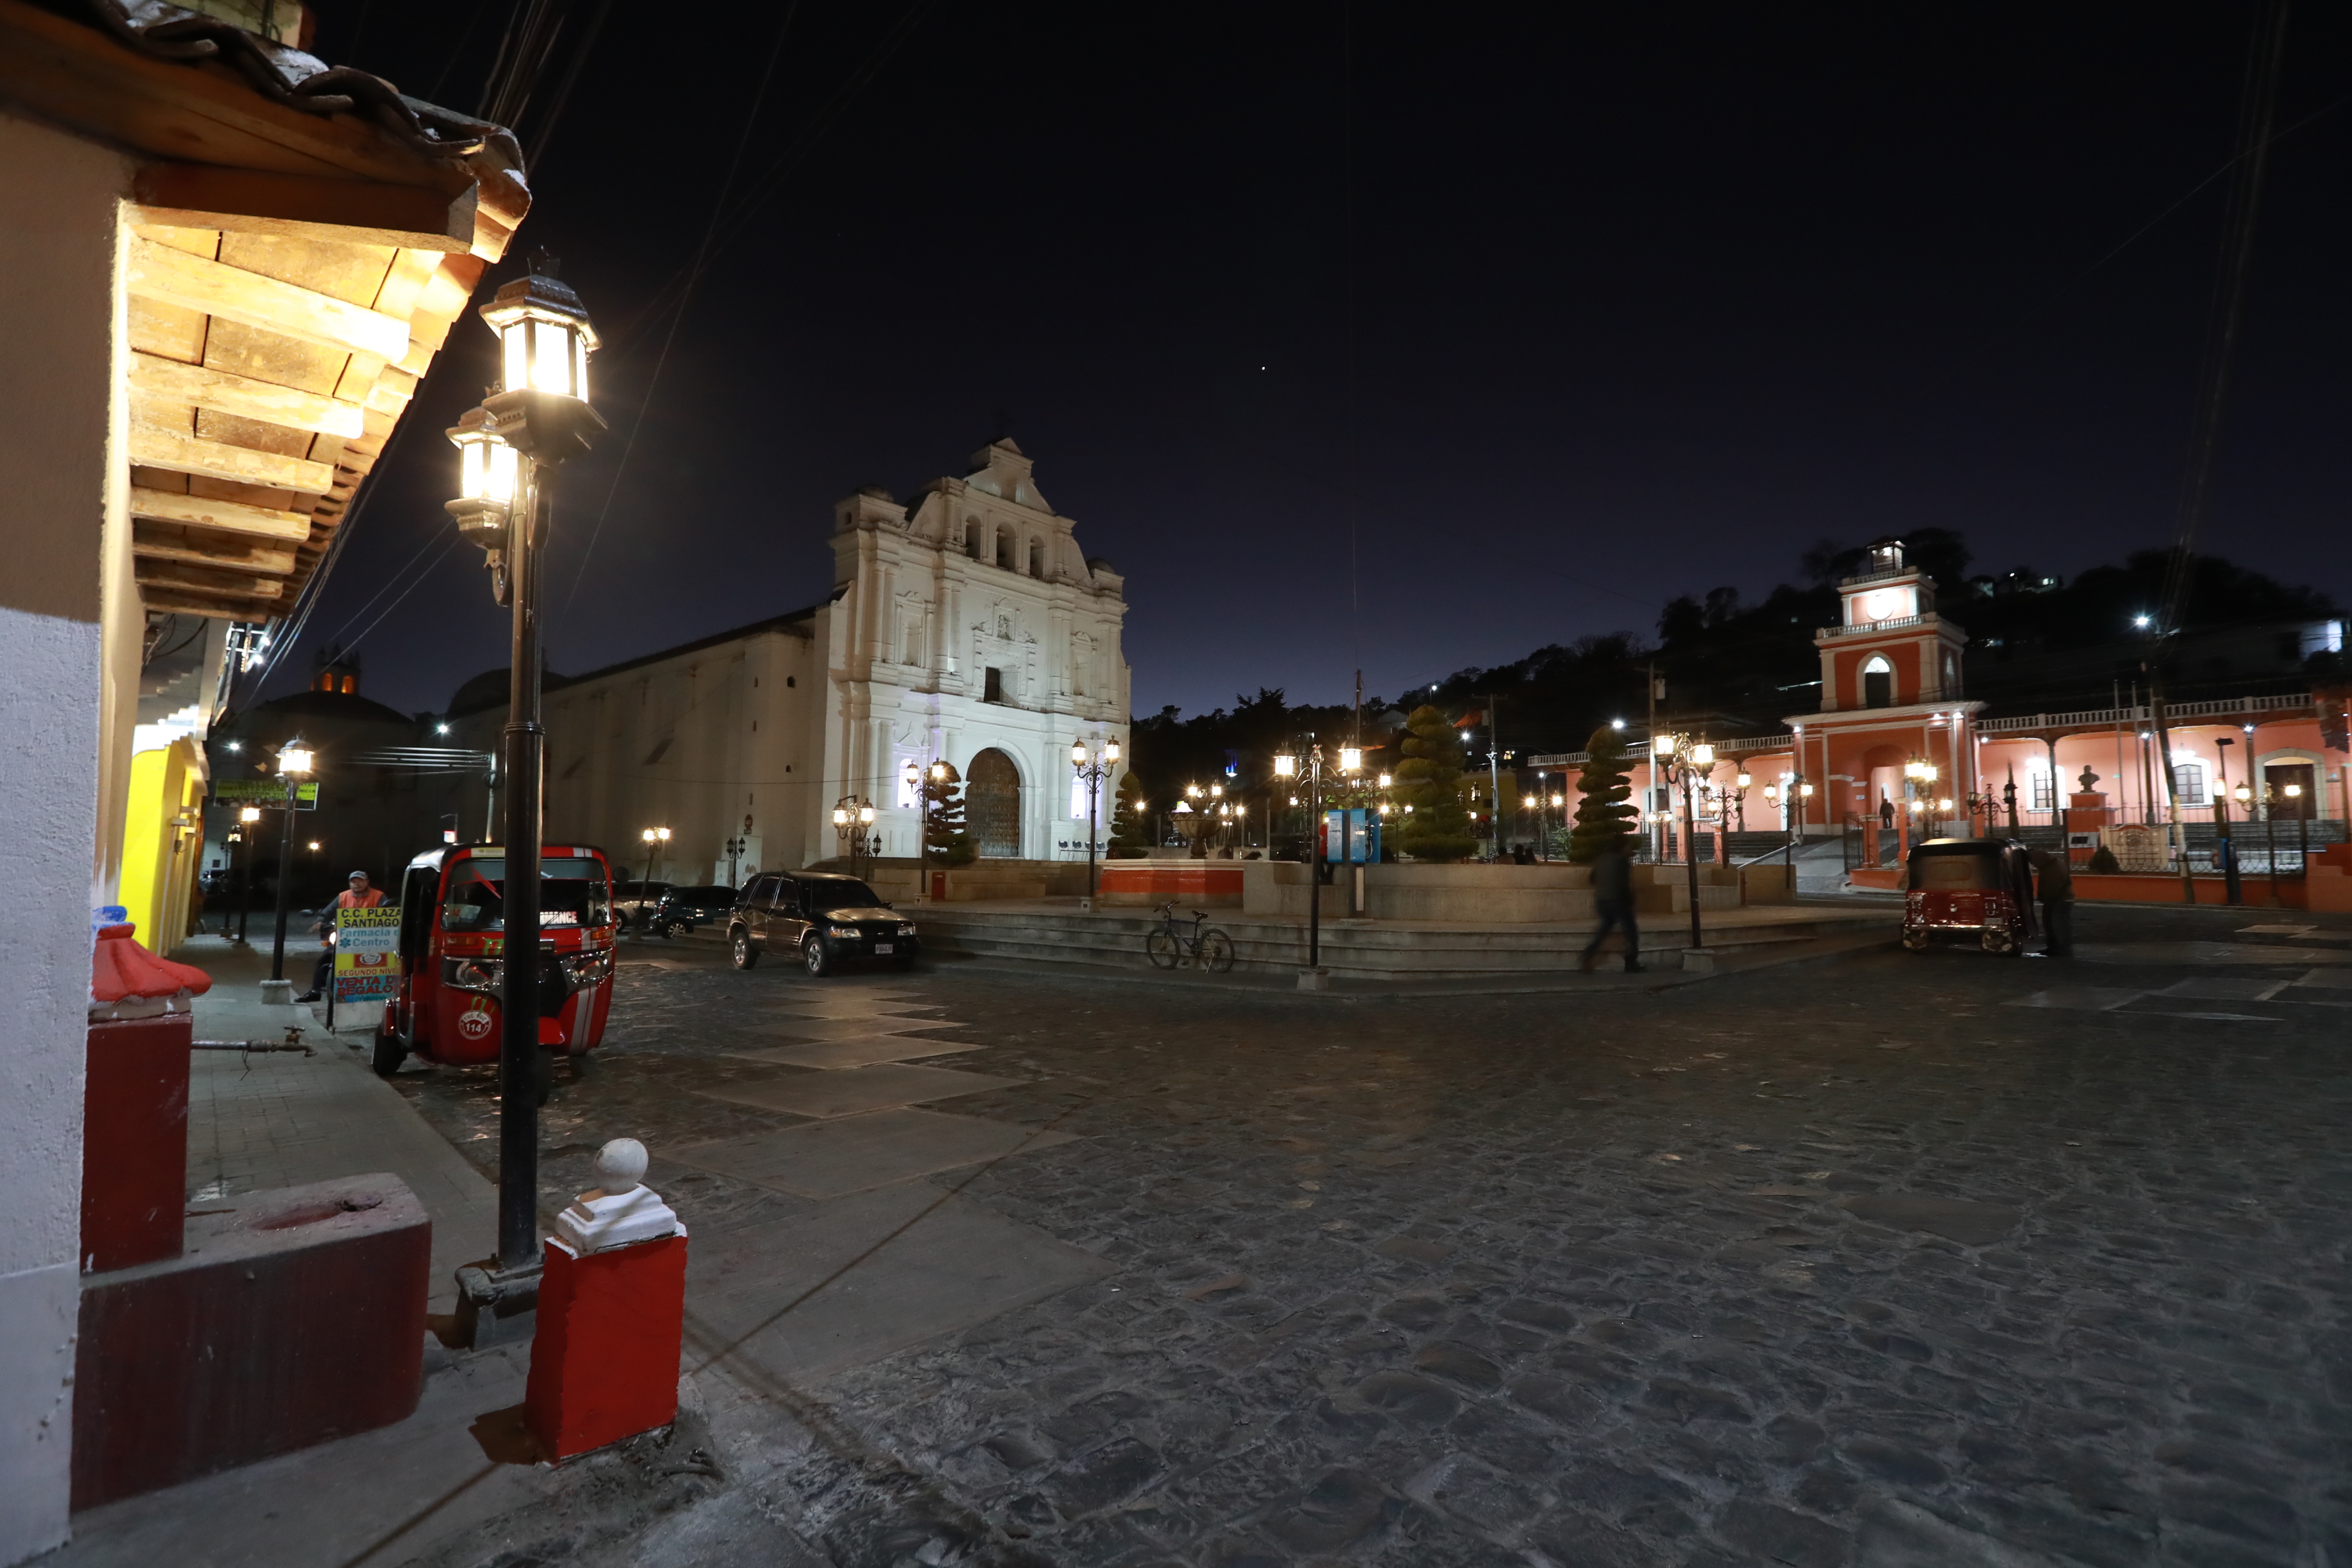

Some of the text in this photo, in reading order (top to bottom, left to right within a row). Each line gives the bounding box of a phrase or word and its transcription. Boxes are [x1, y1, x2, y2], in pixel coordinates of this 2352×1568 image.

[342, 908, 401, 918] C.C. PLAZA
[344, 919, 399, 928] SANTIAGO
[340, 928, 390, 937] Farmacia
[353, 938, 389, 947] Centro
[336, 975, 394, 986] VENTA D
[466, 1023, 482, 1032] 114
